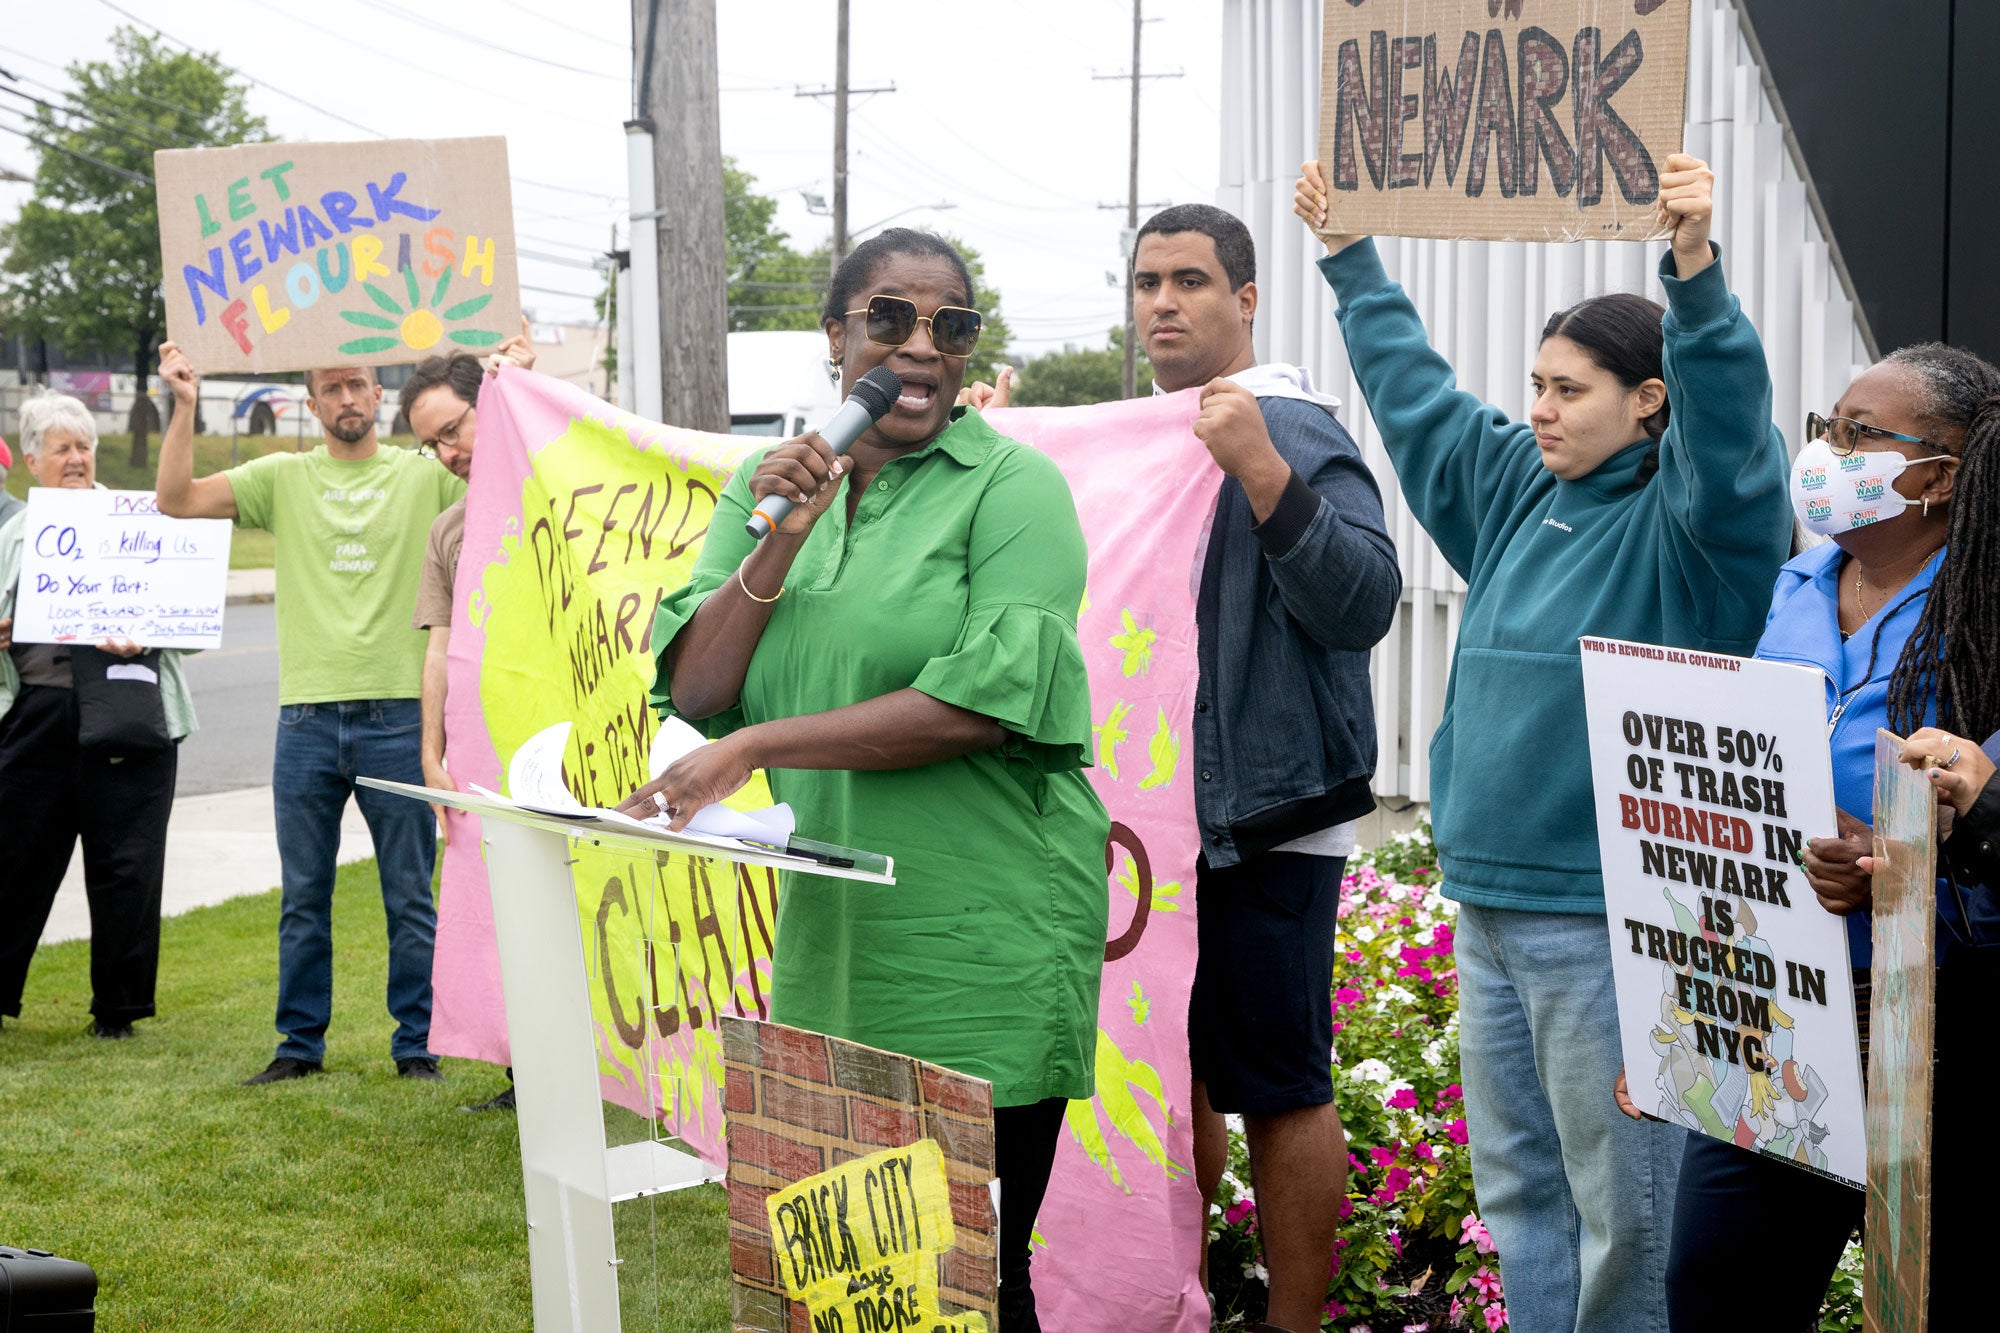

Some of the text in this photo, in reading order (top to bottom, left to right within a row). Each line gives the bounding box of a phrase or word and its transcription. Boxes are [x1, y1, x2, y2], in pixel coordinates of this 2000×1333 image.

[1333, 26, 1659, 207] NEWARK
[194, 160, 294, 239] LET
[183, 172, 441, 326] NEWARK
[219, 227, 495, 355] FLOURISH
[1800, 467, 1826, 478] SOUTH
[1801, 474, 1827, 485] WARD
[1840, 455, 1866, 467] WARD
[1854, 477, 1883, 489] SOUTH
[1855, 485, 1884, 496] WARD
[1805, 498, 1831, 509] SOUTH
[1806, 506, 1832, 516] WARD
[1849, 509, 1877, 521] SOUTH
[1548, 518, 1573, 533] Studios
[99, 540, 110, 554] is
[336, 544, 367, 556] PARA
[532, 472, 718, 637] DEFEND
[37, 573, 148, 596] Do Your Part:
[329, 560, 377, 572] NEWARK
[48, 603, 83, 619] LOOK
[87, 601, 145, 618] FORWARD
[51, 623, 83, 635] NOT
[569, 586, 663, 711] NEWAR
[1582, 639, 1741, 673] WHO IS REWORLD AKA COVANTA?
[1622, 711, 1783, 773] OVER 50%
[1627, 753, 1788, 819] OF TRASH
[1619, 793, 1803, 867] BURNED IN
[1640, 839, 1791, 908] NEWARK
[1701, 896, 1735, 937] IS
[1624, 918, 1827, 1006] TRUCKED IN
[1675, 972, 1772, 1034] FROM
[1694, 1019, 1772, 1076] NYC.
[776, 1153, 922, 1291] BRICK CITY
[854, 1283, 922, 1333] MORE
